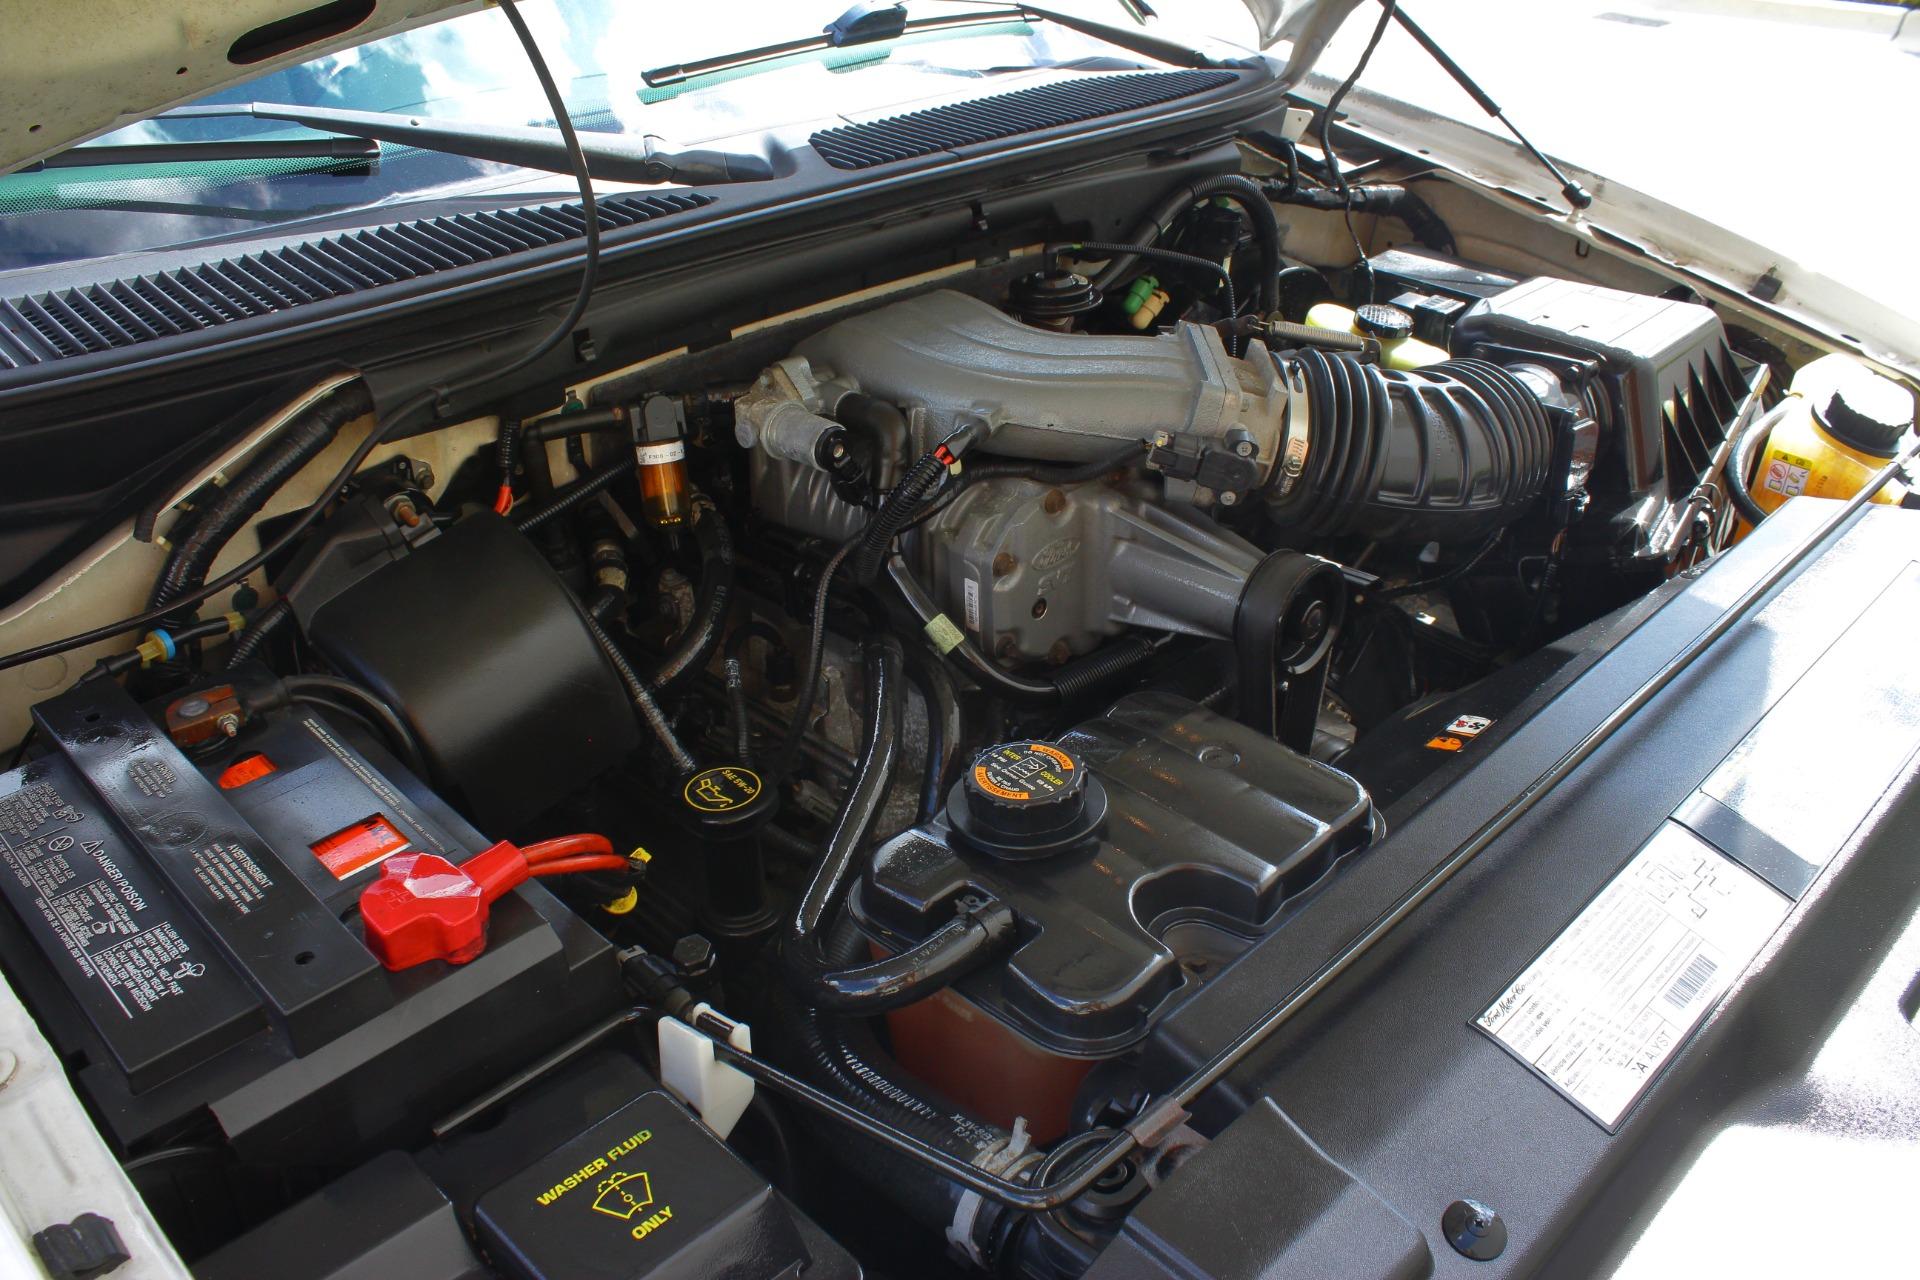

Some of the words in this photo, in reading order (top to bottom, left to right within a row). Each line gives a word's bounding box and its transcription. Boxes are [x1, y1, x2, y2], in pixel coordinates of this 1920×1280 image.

[1002, 748, 1021, 761] INTER
[1043, 747, 1071, 768] WARNING
[722, 769, 737, 780] SAE
[734, 779, 755, 794] 5W-20
[976, 771, 1023, 798] AVERTISSEMENT
[1002, 769, 1019, 780] Owner
[1019, 778, 1036, 791] Guide
[1040, 771, 1064, 786] COOLER
[63, 868, 76, 879] LES
[93, 850, 148, 911] DANGER/POISON
[226, 843, 273, 888] AVERTISSEMENT
[66, 893, 92, 921] SULFURIQUE
[96, 880, 117, 902] SULFURIC
[112, 901, 127, 915] ACID
[33, 897, 47, 910] TENIR
[41, 908, 56, 921] HORS
[69, 947, 82, 958] DES
[162, 924, 178, 939] FLUSH
[174, 939, 189, 952] EYES
[112, 946, 129, 962] L'EAU
[142, 932, 158, 946] WITH
[153, 946, 170, 963] WATER
[93, 955, 121, 986] RAPIDEMENT
[103, 950, 129, 979] CONSULTER
[123, 978, 136, 989] UN
[130, 987, 153, 1011] MÉDECIN
[122, 941, 134, 950] SE
[140, 966, 155, 978] LES
[148, 977, 164, 991] YEUX
[132, 936, 147, 948] GET
[141, 947, 162, 968] MEDICAL
[157, 968, 172, 981] HELP
[167, 981, 183, 995] FAST
[1483, 1009, 1502, 1027] Ford
[1498, 993, 1517, 1017] Motor
[1631, 1031, 1672, 1074] AALYST
[536, 1156, 610, 1207] WASHER
[606, 1128, 655, 1162] FLUID
[631, 1205, 674, 1241] ONLY
